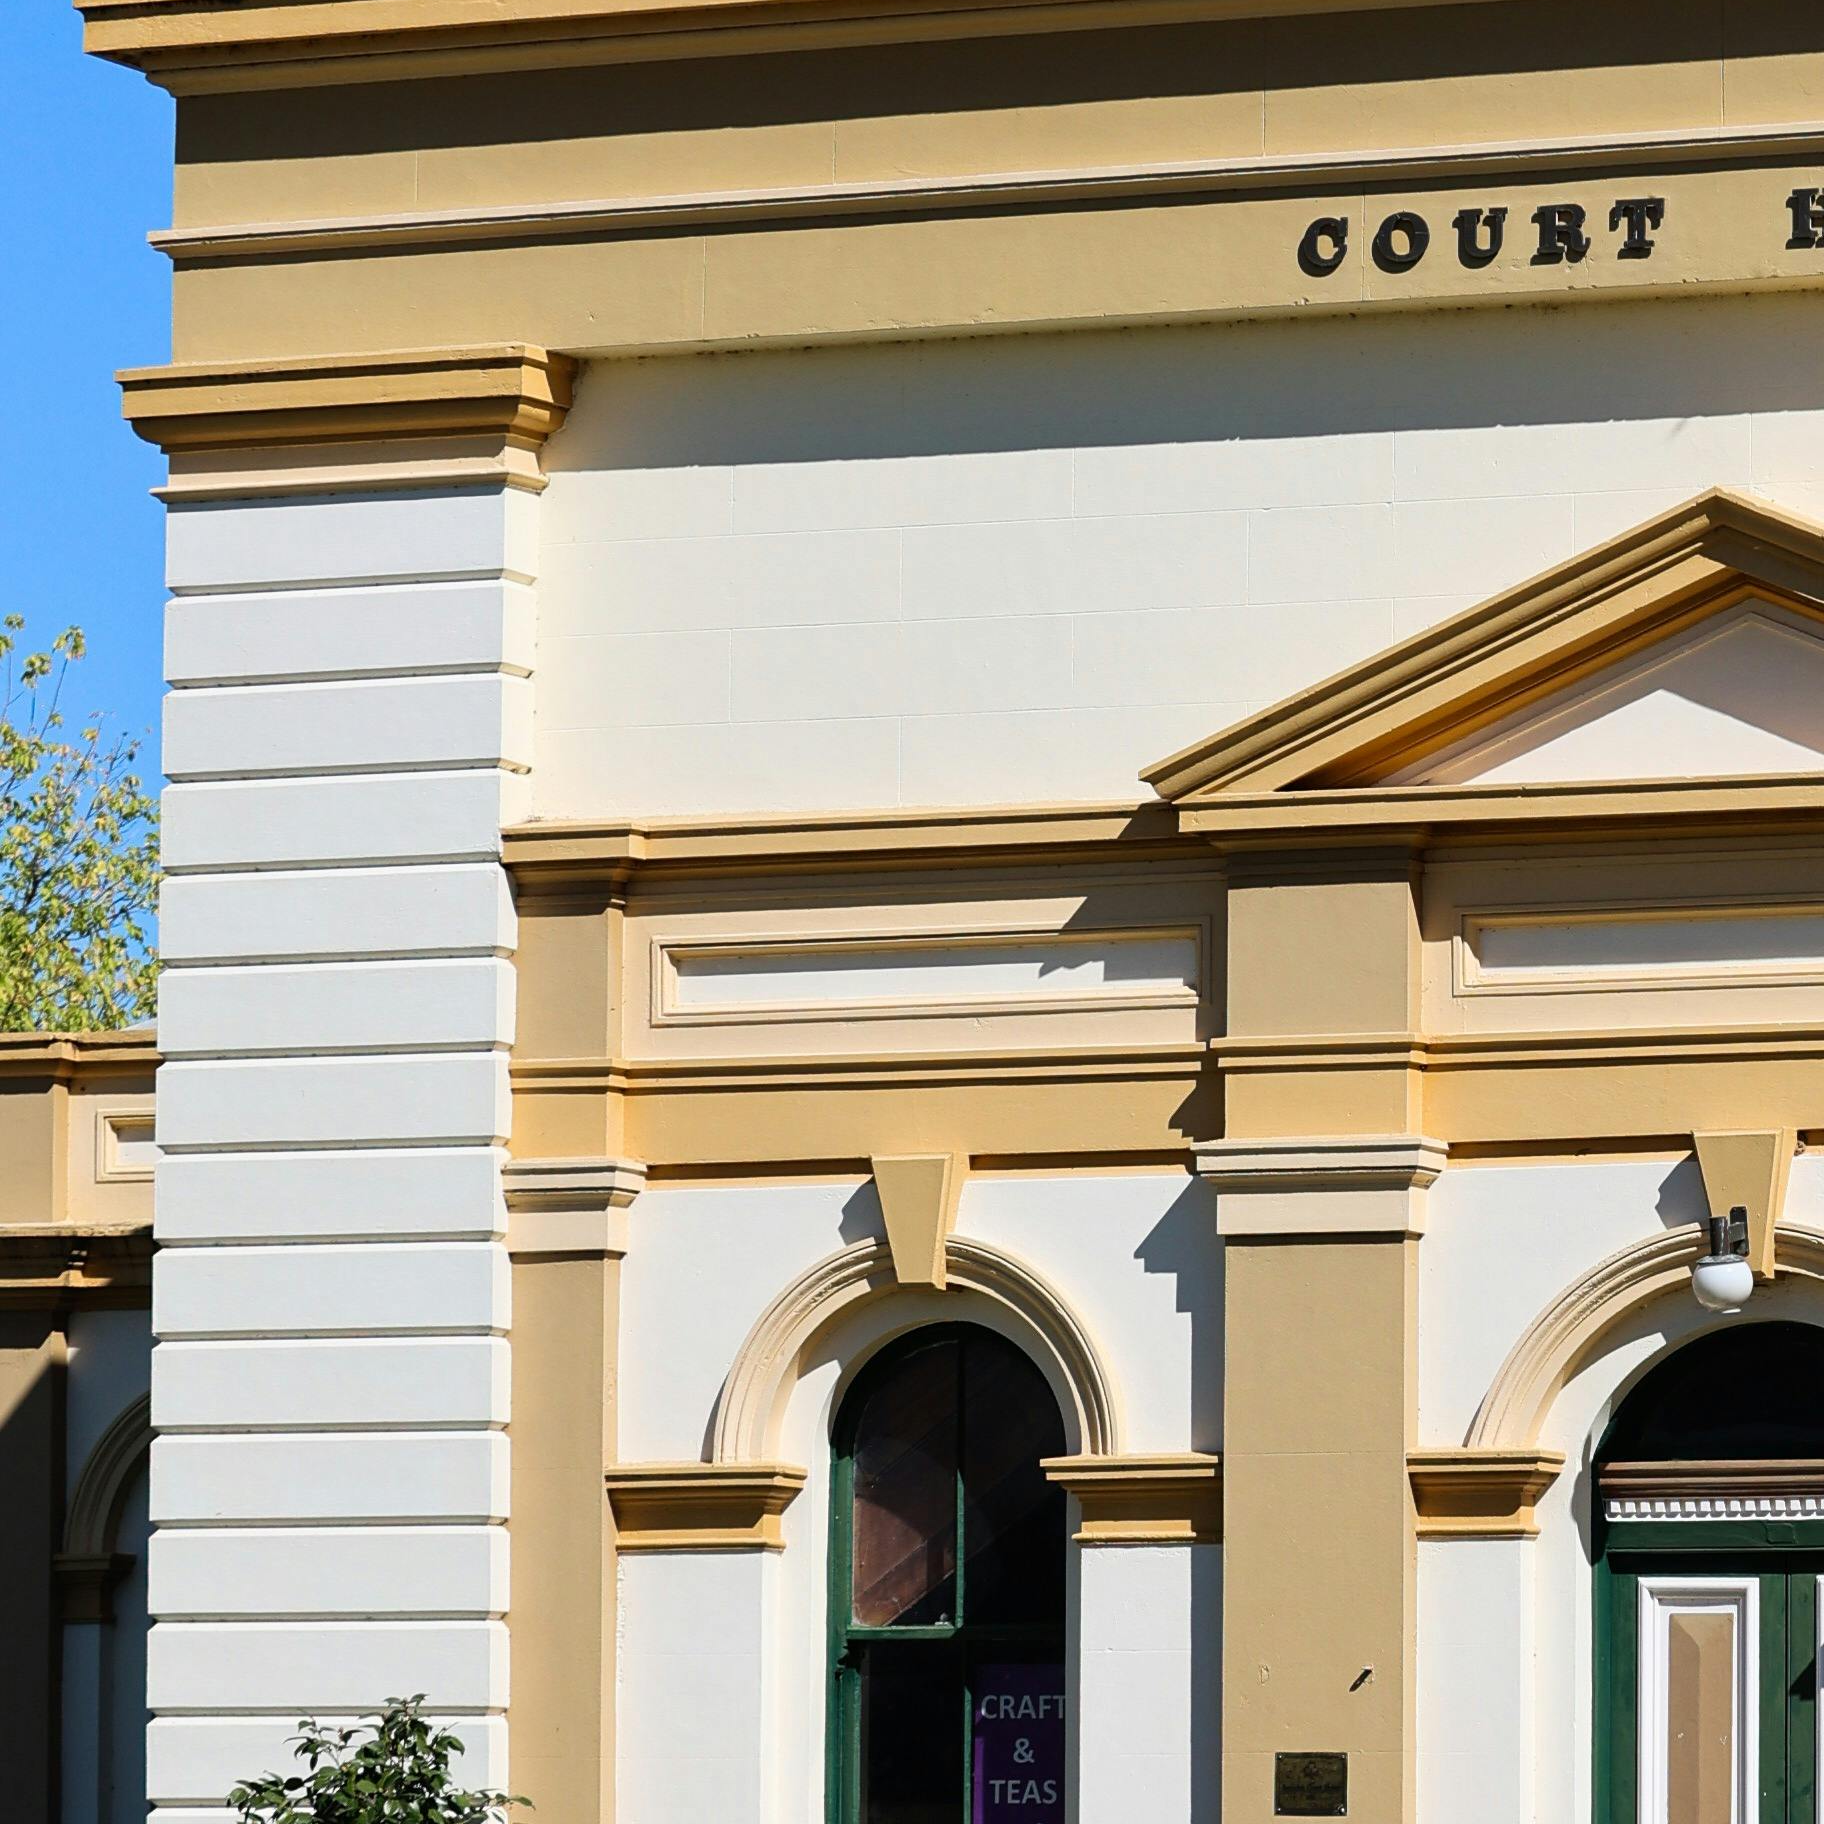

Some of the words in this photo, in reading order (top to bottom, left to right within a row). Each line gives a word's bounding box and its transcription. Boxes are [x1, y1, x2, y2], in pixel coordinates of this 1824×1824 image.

[1298, 197, 1665, 277] COURT
[980, 1694, 1066, 1719] CRAFT
[1012, 1737, 1035, 1764] &
[988, 1779, 1057, 1805] TEAS
